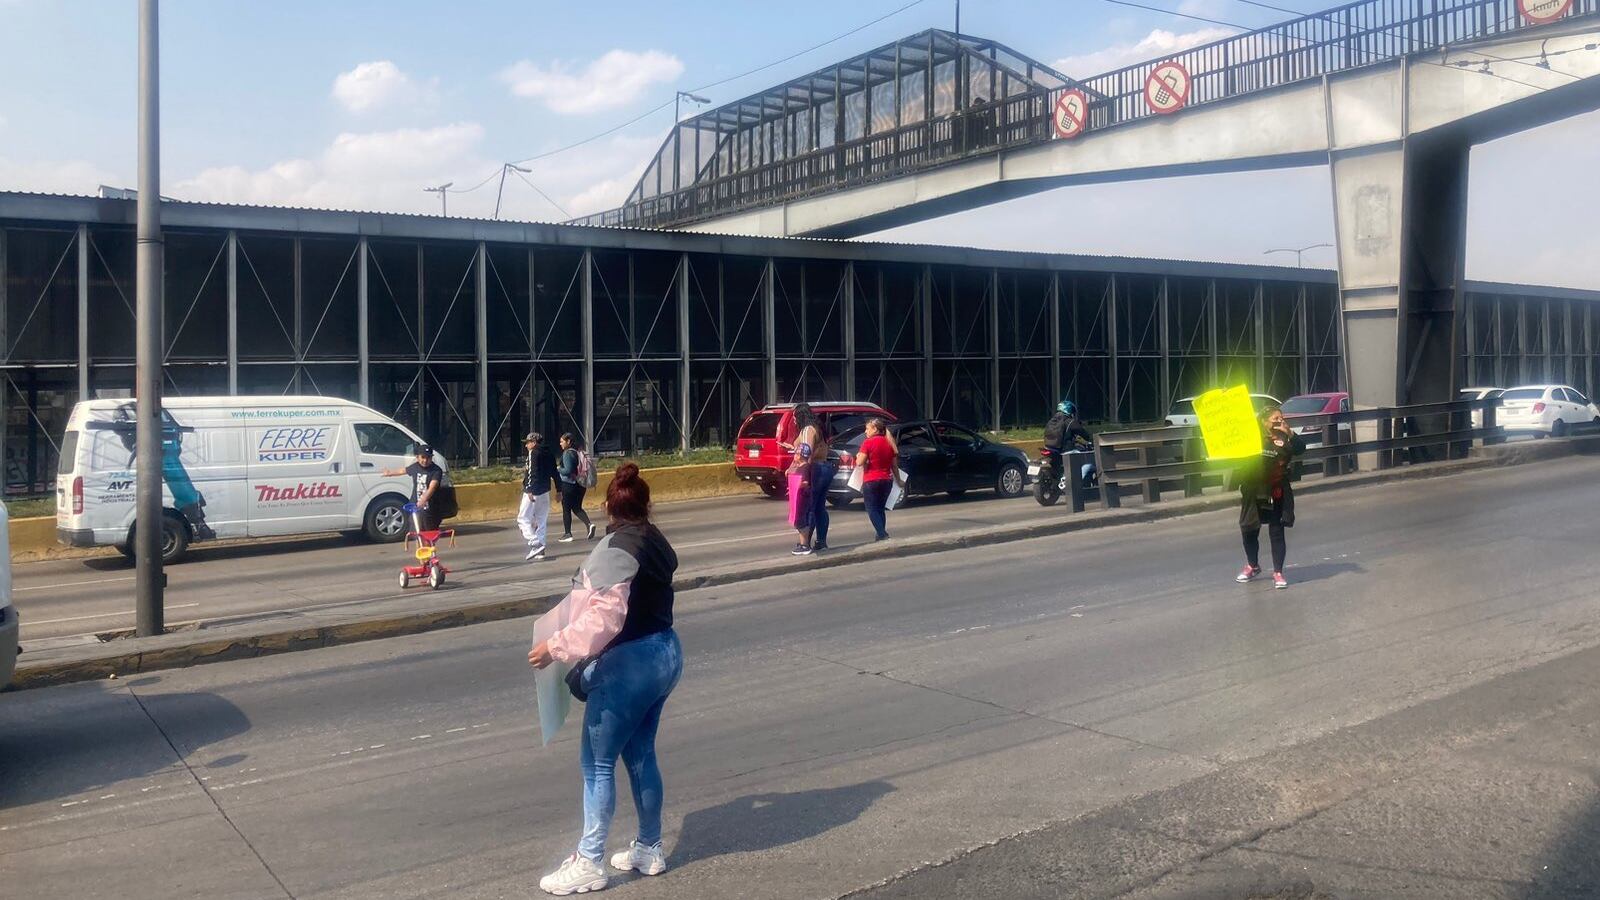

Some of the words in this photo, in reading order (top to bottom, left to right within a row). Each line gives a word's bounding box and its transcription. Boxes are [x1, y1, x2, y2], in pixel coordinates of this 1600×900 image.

[231, 409, 341, 419] www.ferrekuper.com.mx
[259, 427, 330, 449] FERRE
[259, 452, 326, 462] KUPER
[107, 480, 133, 490] AVT
[255, 482, 342, 501] Makita
